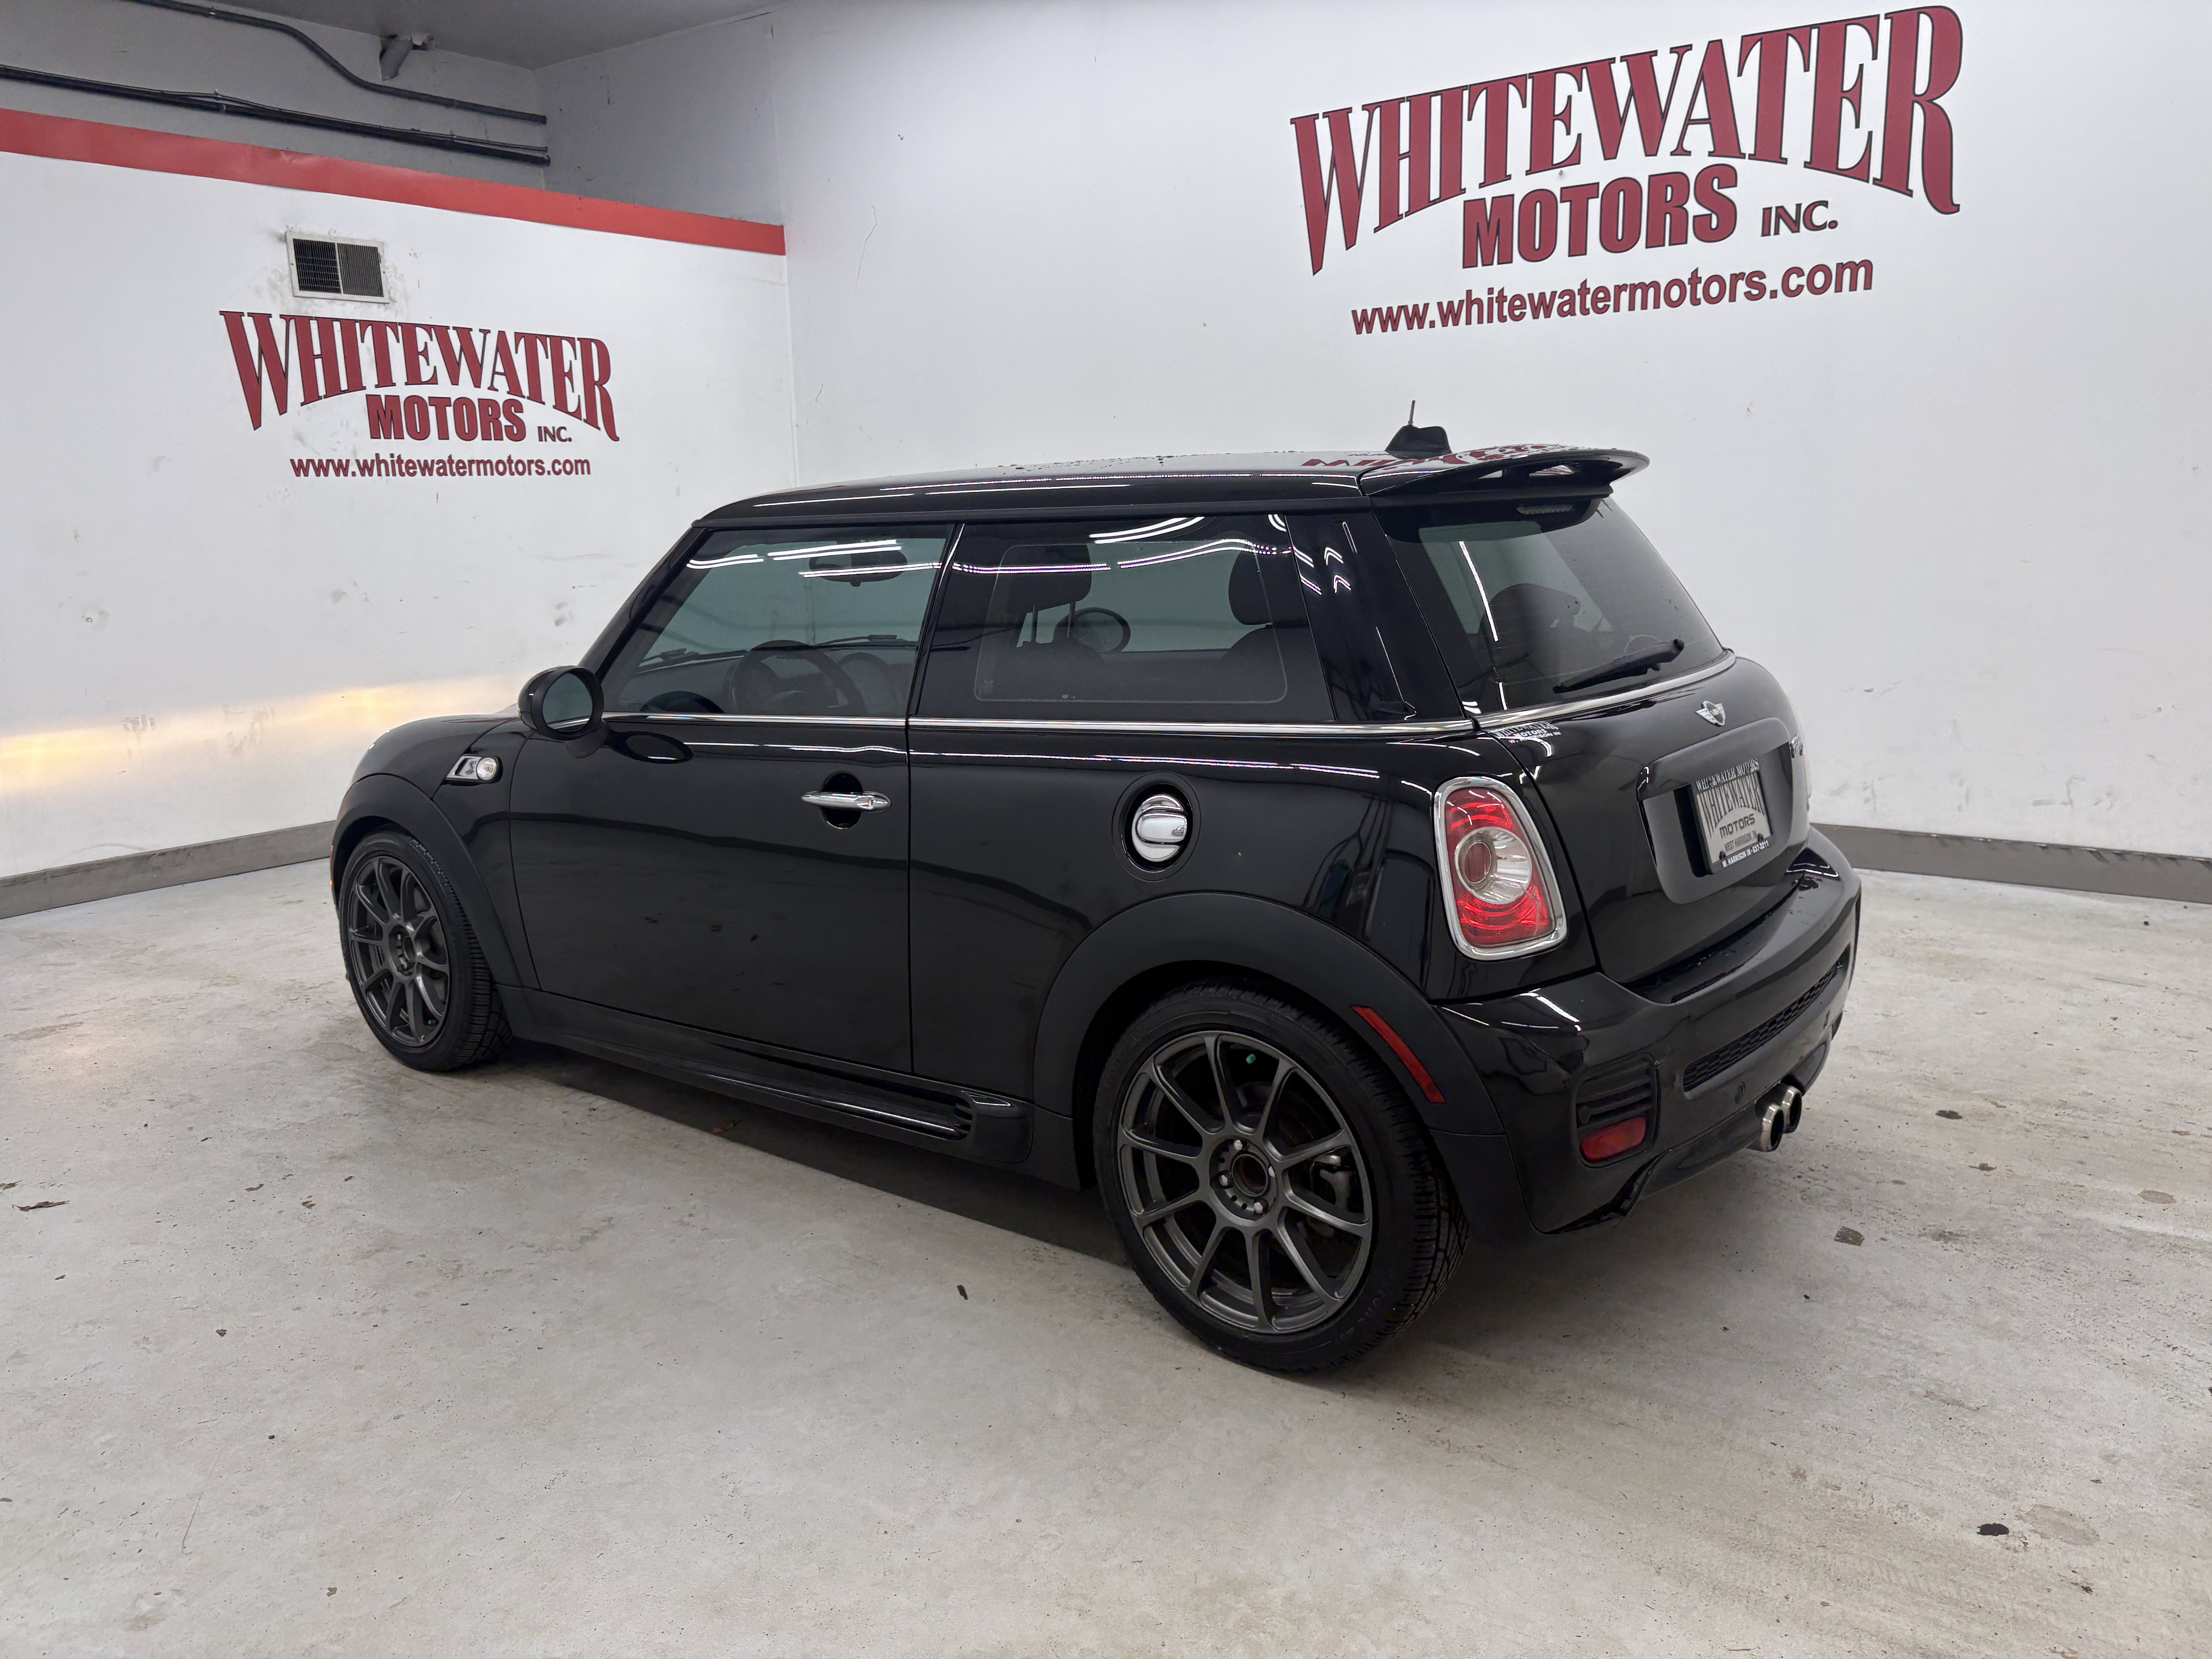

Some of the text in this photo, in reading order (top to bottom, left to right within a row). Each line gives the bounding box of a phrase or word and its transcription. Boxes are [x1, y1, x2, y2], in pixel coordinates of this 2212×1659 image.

[1290, 5, 1963, 276] WHITEWATER
[1462, 163, 1839, 269] MOTORS INC.
[1351, 259, 1874, 335] www.whitewatermotors.com
[219, 311, 620, 442] WHITEWATER
[365, 394, 572, 442] MOTORS INC.
[290, 453, 591, 477] www.whitewatermotors.com
[1514, 728, 1547, 737] MOTORS
[1698, 773, 1765, 839] WHITEWATER
[1719, 813, 1755, 839] MOTORS
